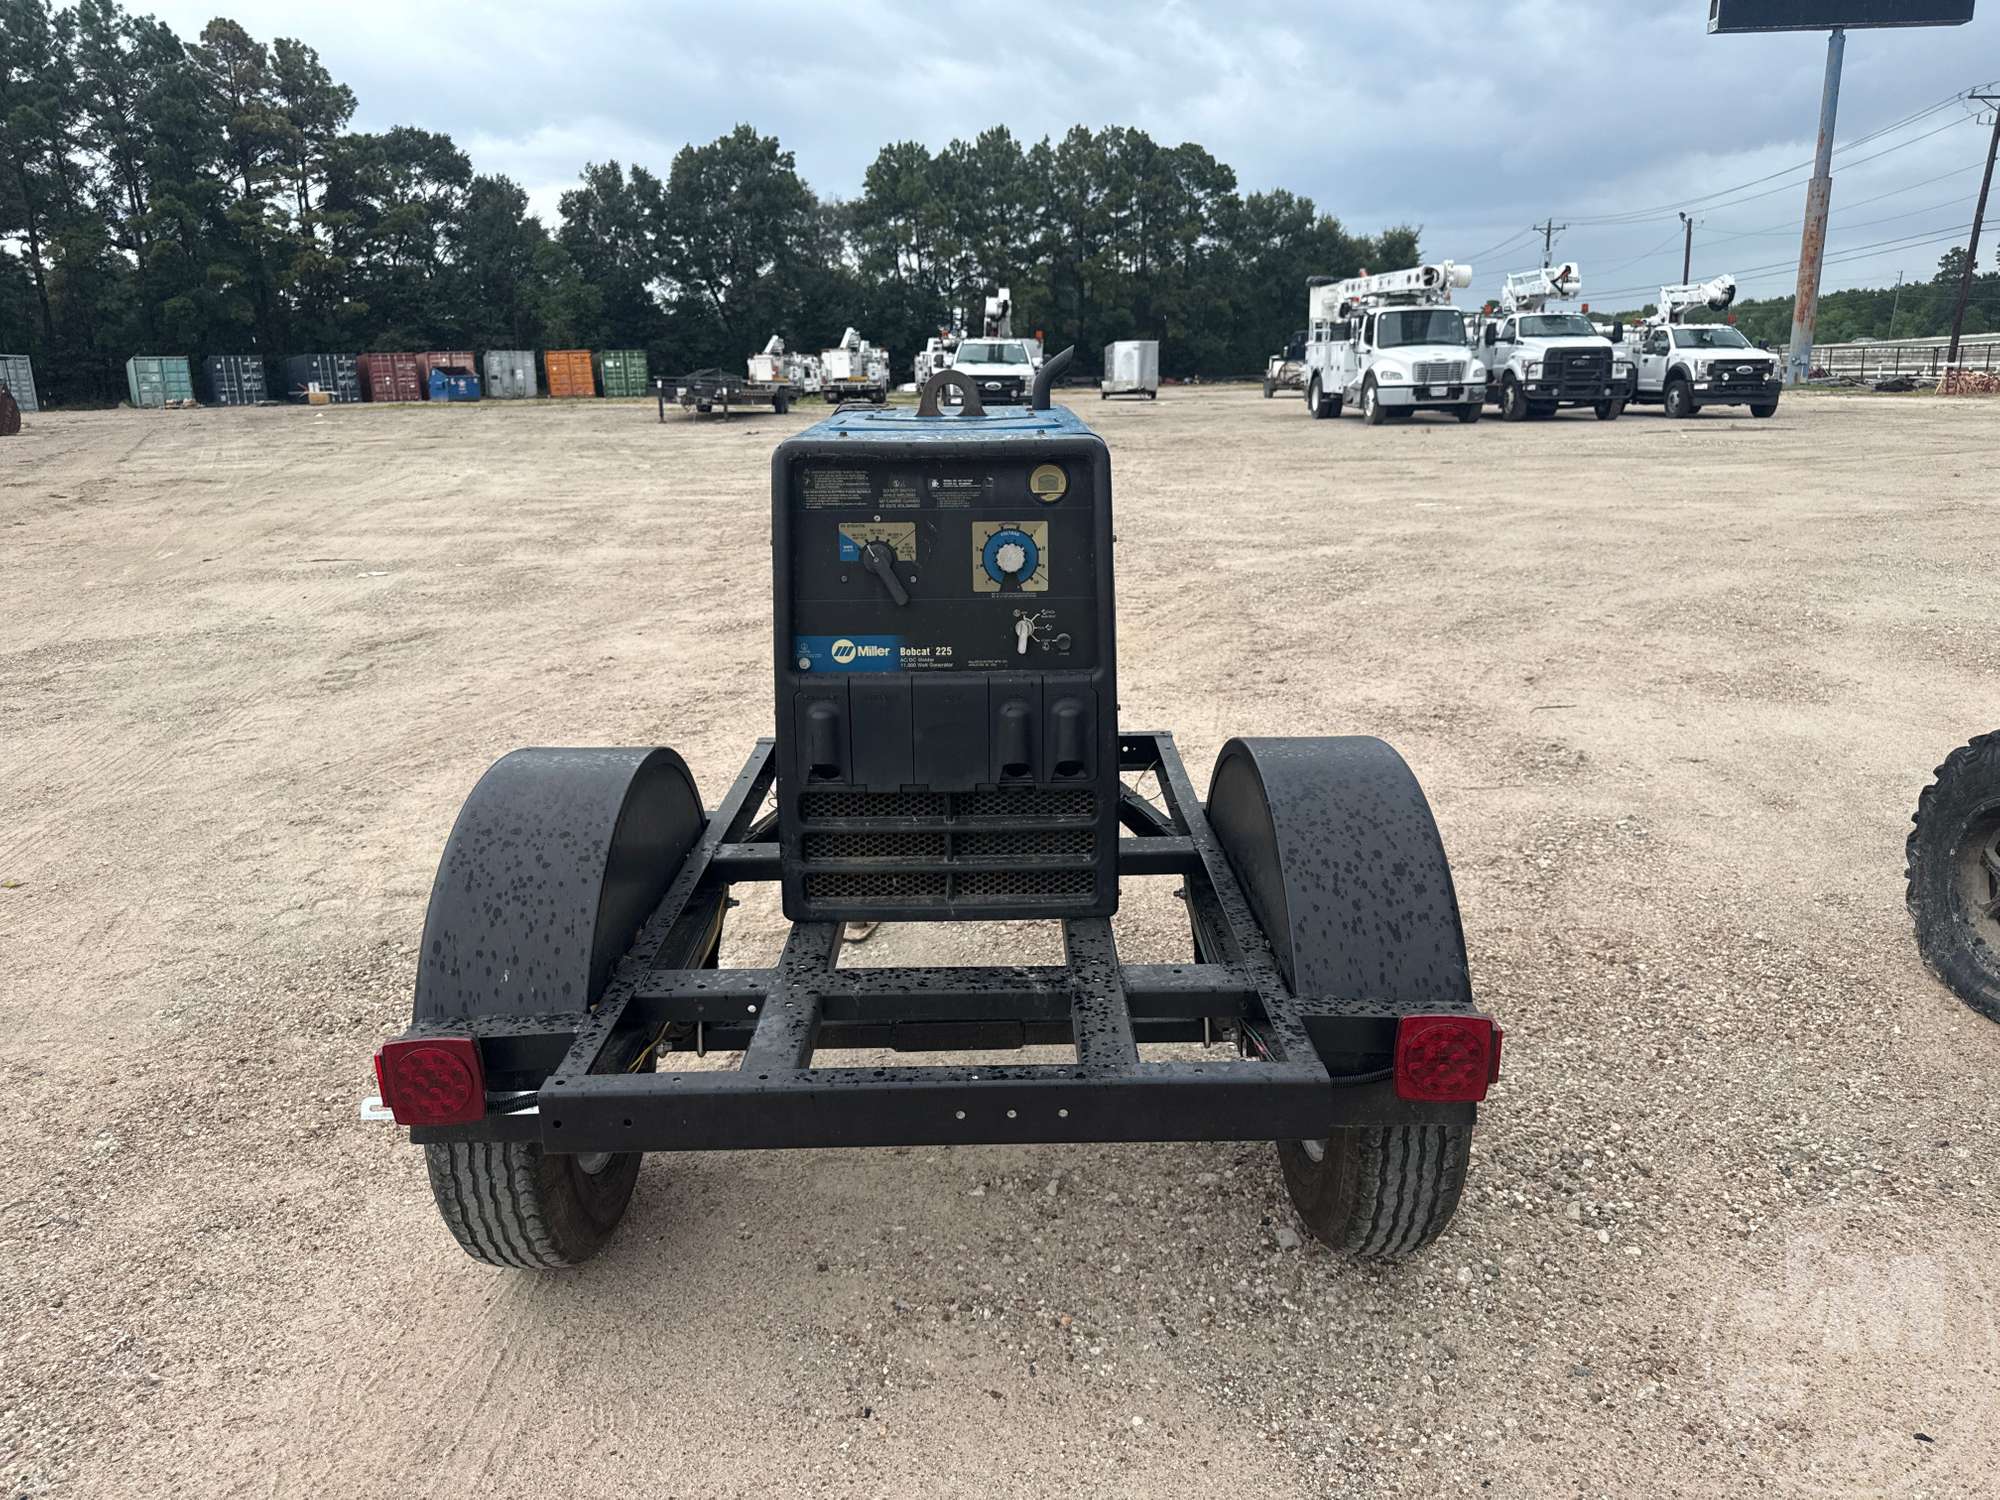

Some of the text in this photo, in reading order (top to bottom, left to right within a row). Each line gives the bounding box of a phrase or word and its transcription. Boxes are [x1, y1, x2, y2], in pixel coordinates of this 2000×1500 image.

[857, 646, 889, 656] Miller
[900, 646, 952, 656] Bobcat 225
